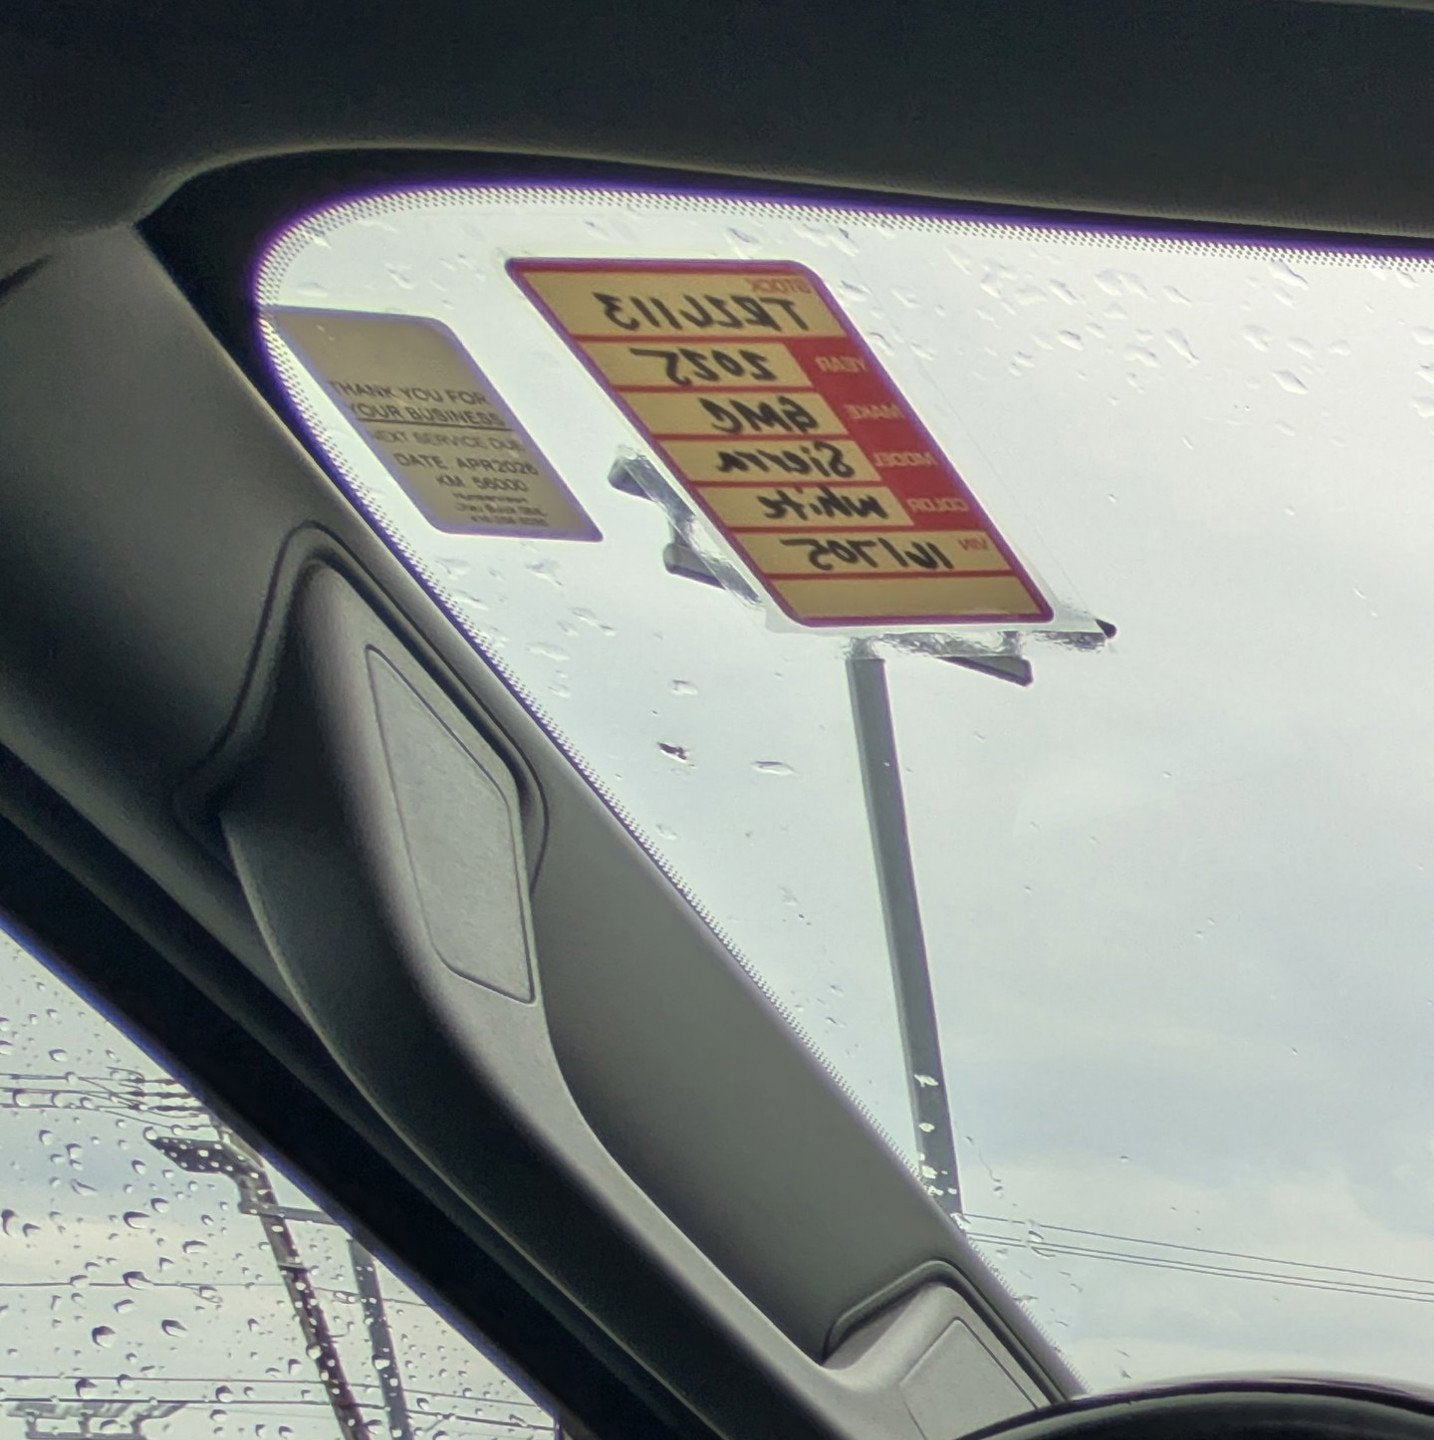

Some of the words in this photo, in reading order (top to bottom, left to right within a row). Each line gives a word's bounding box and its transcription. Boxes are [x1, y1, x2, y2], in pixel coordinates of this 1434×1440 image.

[328, 380, 401, 398] THANK
[401, 386, 444, 403] YOU
[449, 390, 488, 407] FOR
[350, 402, 405, 419] YOUR
[408, 405, 507, 427] BUSINESS
[413, 431, 481, 449] SERVICE
[394, 452, 446, 470] DATE
[436, 474, 466, 488] KM
